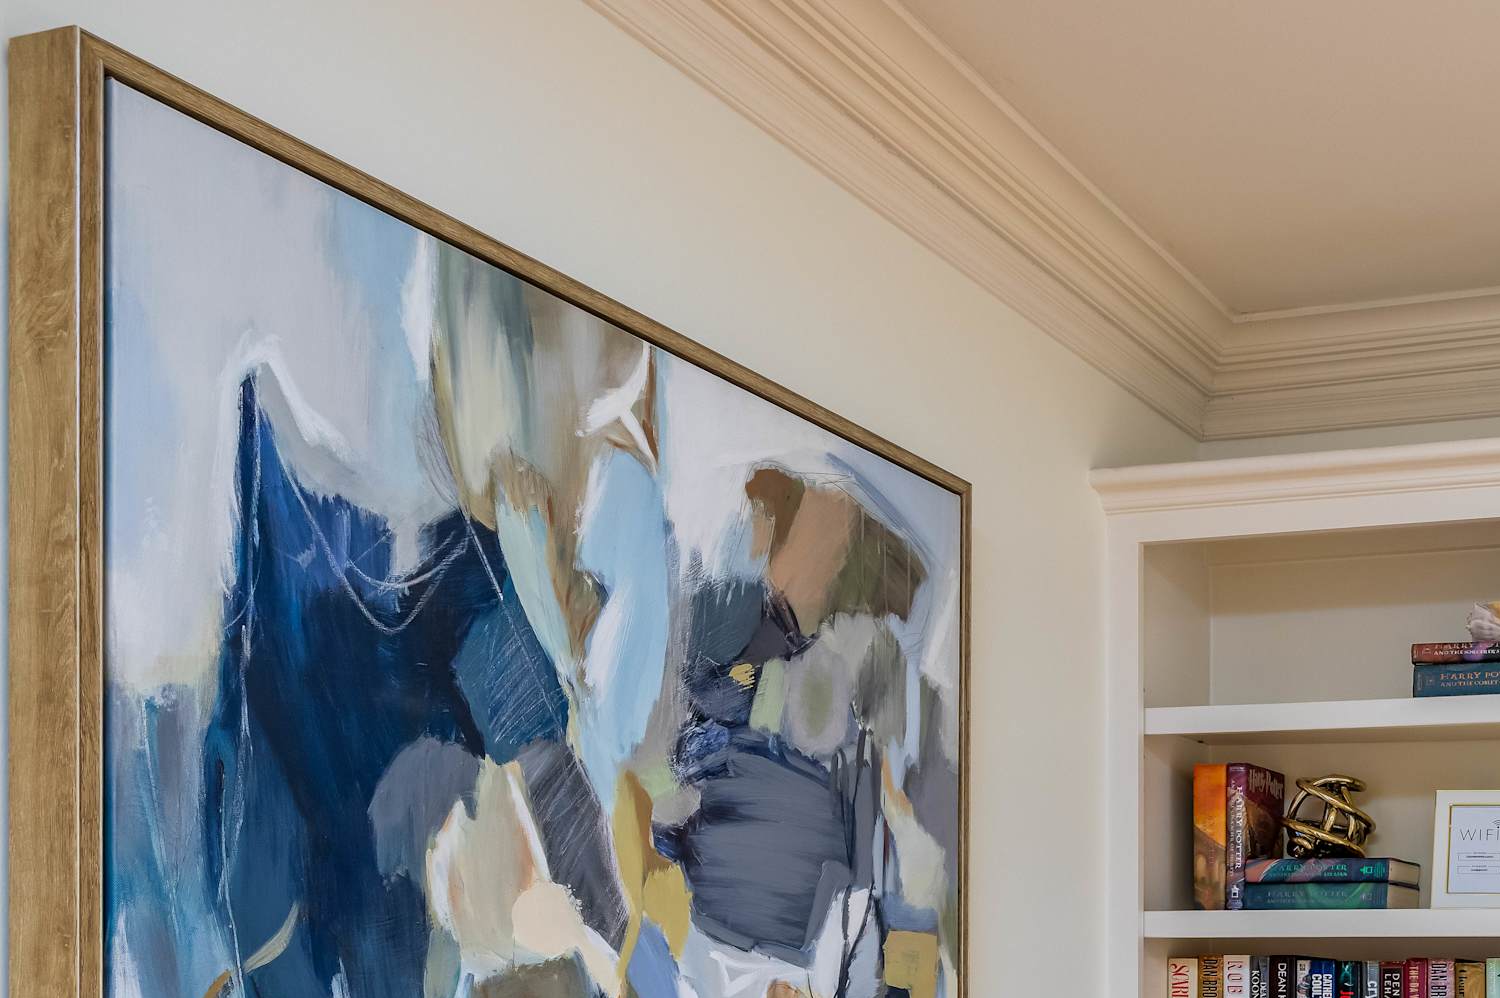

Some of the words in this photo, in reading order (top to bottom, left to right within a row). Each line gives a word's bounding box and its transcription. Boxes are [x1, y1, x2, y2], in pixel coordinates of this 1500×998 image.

[1440, 672, 1481, 680] HARRY
[1249, 768, 1266, 793] Harry
[1265, 771, 1284, 800] Potter
[1234, 786, 1244, 826] HARRY
[1234, 830, 1244, 869] POTTER
[1202, 959, 1218, 977] DAN
[1277, 962, 1287, 992] DEAN
[1408, 965, 1419, 980] THE
[1431, 963, 1448, 982] DAN
